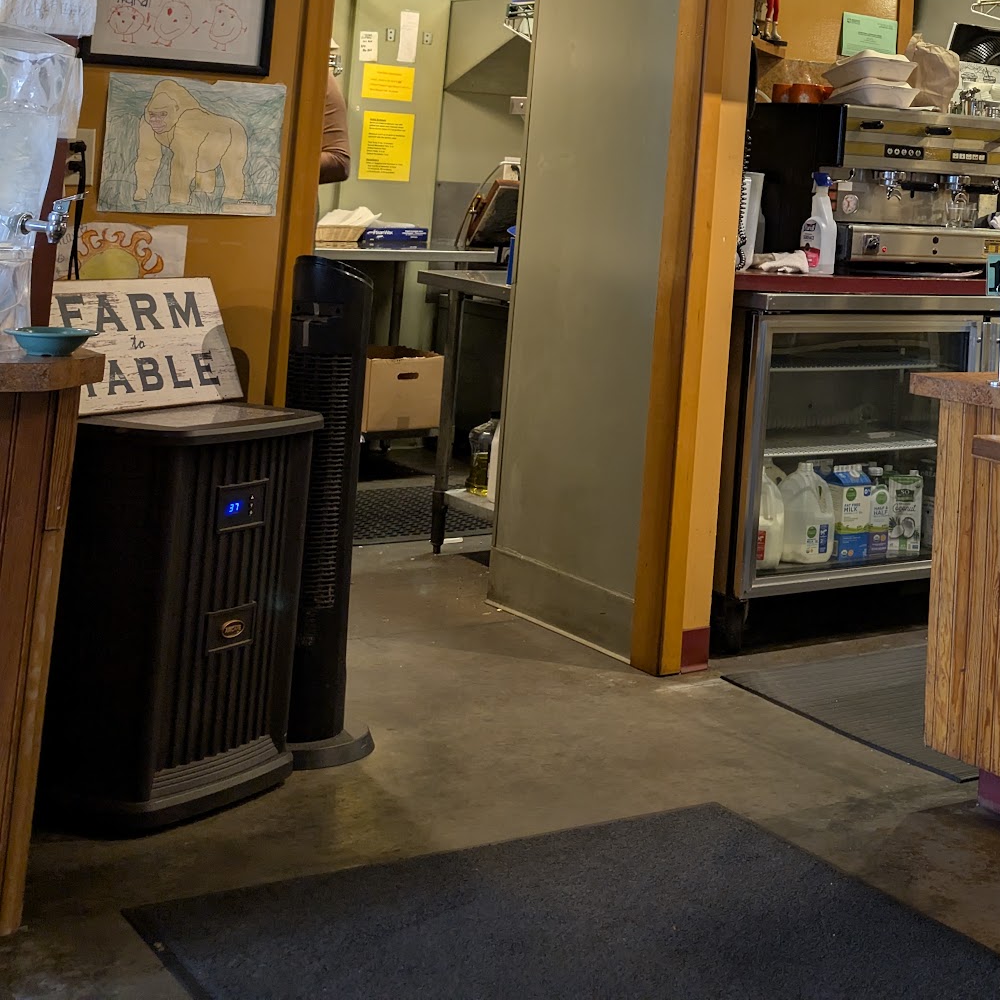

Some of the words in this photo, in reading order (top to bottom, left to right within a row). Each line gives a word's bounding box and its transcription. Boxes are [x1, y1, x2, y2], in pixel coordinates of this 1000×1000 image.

[55, 291, 204, 332] FARM
[130, 335, 146, 350] to
[229, 502, 240, 513] 37
